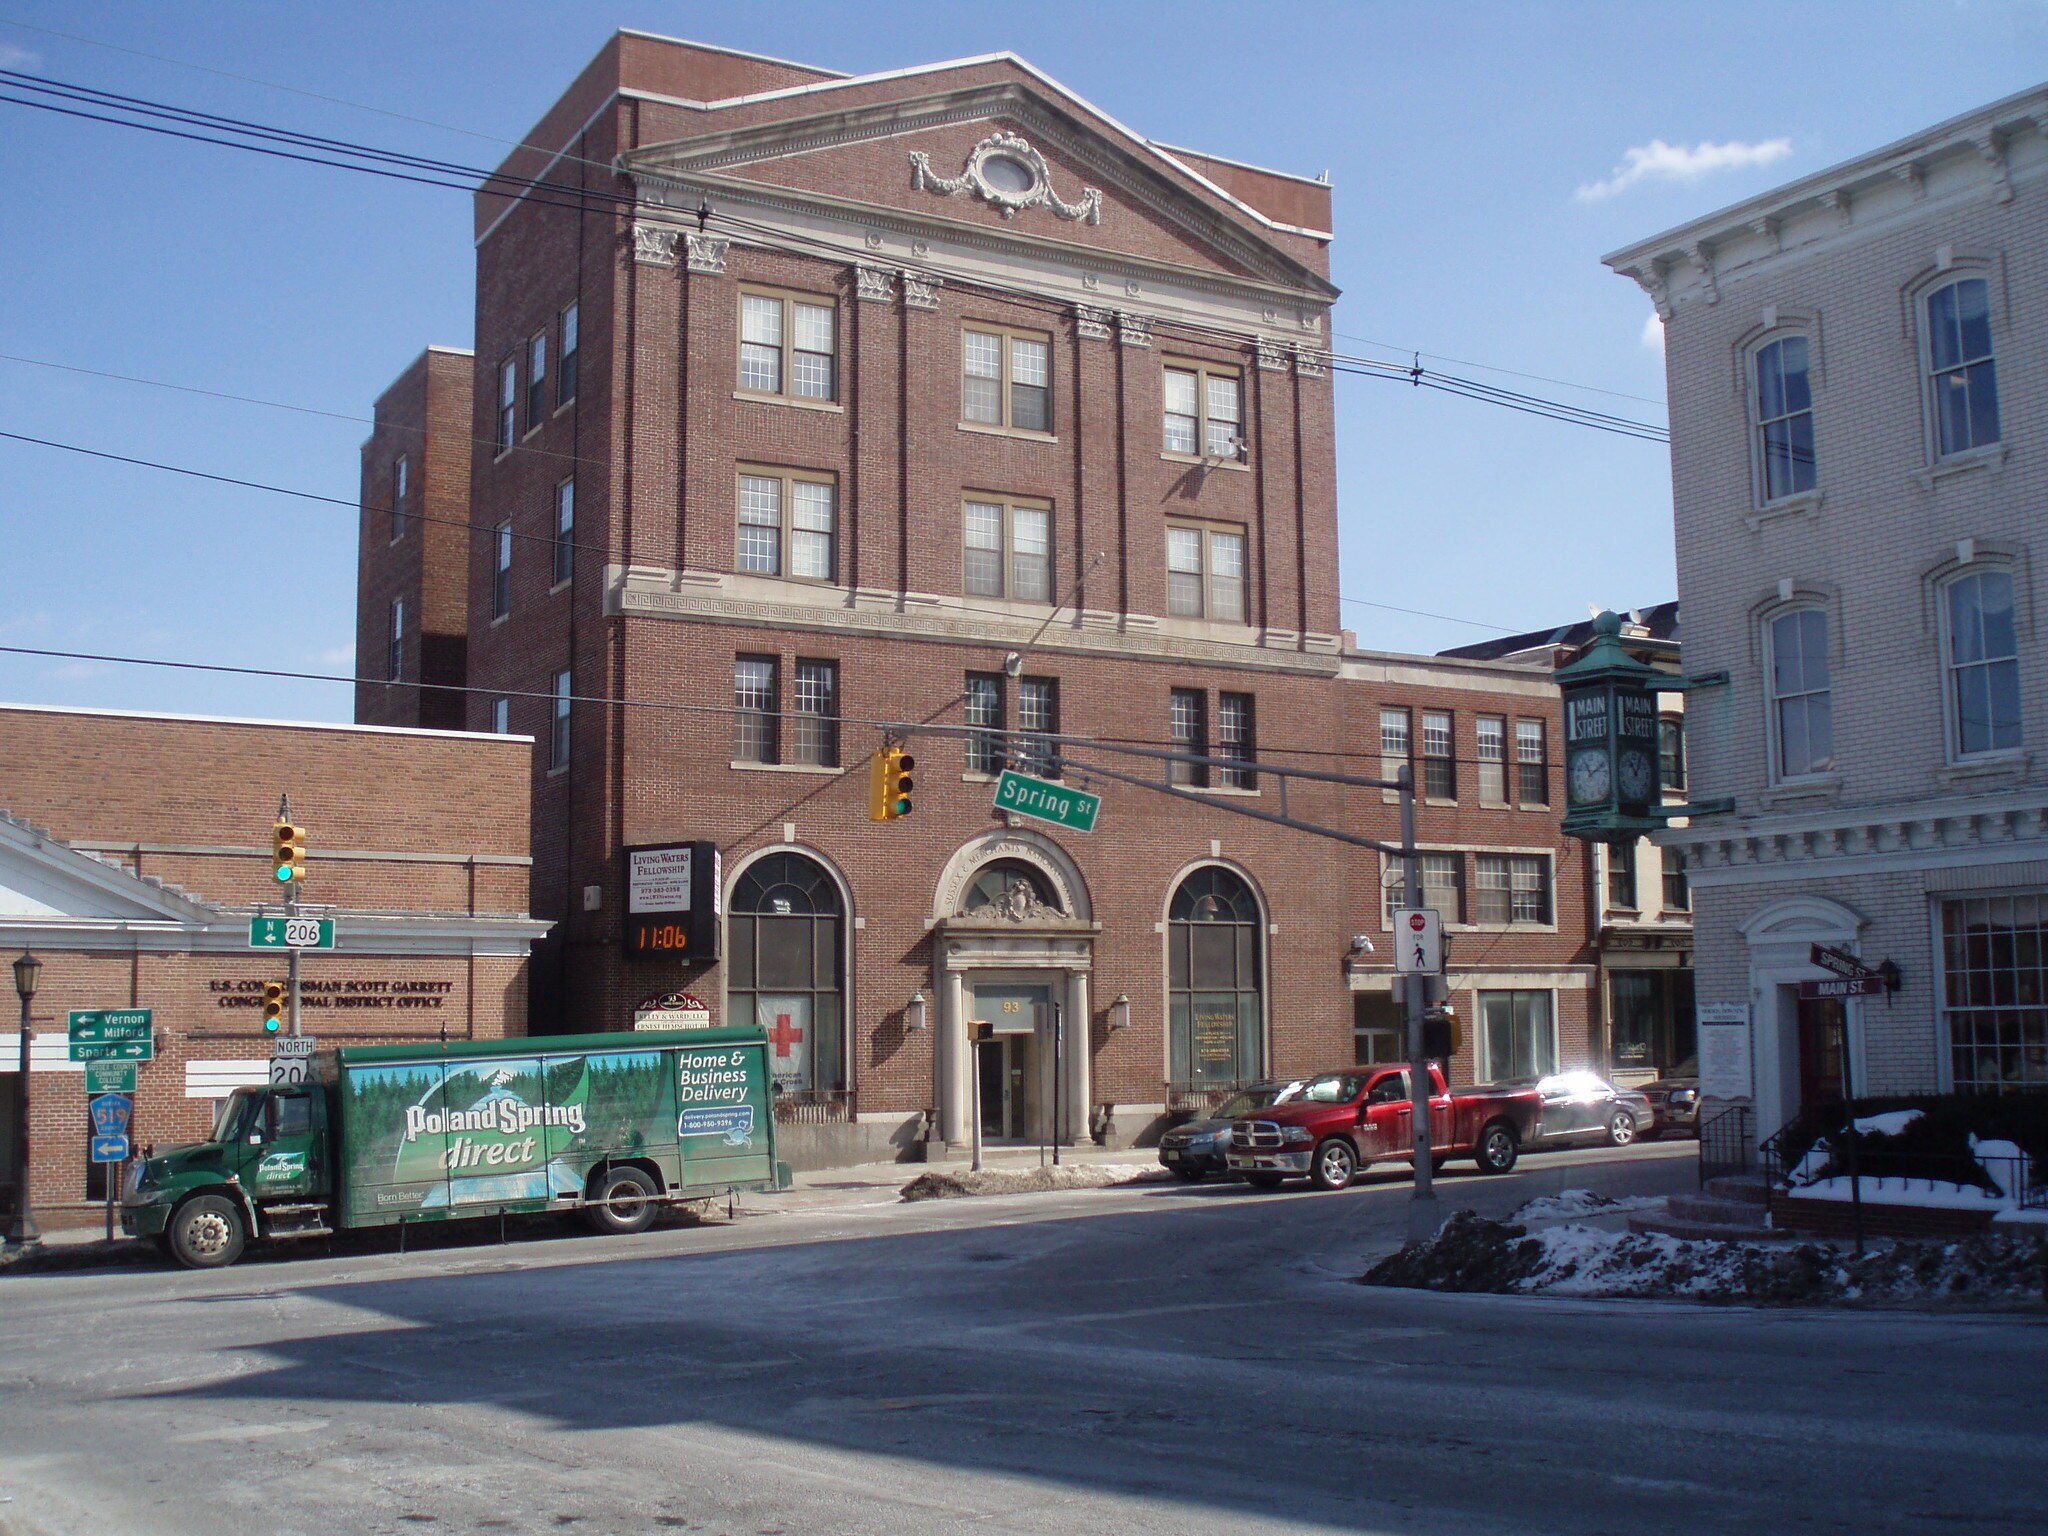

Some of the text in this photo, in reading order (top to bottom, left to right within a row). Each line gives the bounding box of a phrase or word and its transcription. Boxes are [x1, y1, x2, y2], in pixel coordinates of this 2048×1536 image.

[1568, 697, 1606, 740] 1 MAIN
[1617, 696, 1652, 735] 1 MAIN
[1577, 716, 1608, 740] STREET
[1626, 716, 1654, 738] STREET
[1004, 780, 1092, 820] Spring St
[633, 853, 689, 865] LIVING WATERS
[638, 866, 685, 876] FELLOWSHIP
[266, 921, 317, 940] N 206
[640, 925, 686, 949] 11:06
[1821, 951, 1854, 976] SPRING
[344, 981, 390, 992] SCOTT
[392, 982, 453, 993] GARRETT
[1818, 980, 1866, 995] MAIN ST.
[334, 996, 394, 1008] DISTRICT
[396, 996, 443, 1008] OFFICE
[1003, 1002, 1019, 1013] 93
[104, 1014, 144, 1024] Vernon
[104, 1027, 144, 1038] Milford
[78, 1046, 117, 1058] Sparta
[278, 1042, 313, 1053] NORTH
[680, 1051, 745, 1069] Home &
[680, 1069, 747, 1085] Business
[682, 1085, 748, 1102] Delivery
[97, 1108, 127, 1124] 519
[406, 1098, 586, 1142] Poland Spring
[438, 1136, 536, 1170] direct
[259, 1161, 304, 1172] Poland Spring
[266, 1172, 290, 1180] direct
[377, 1192, 397, 1201] Born
